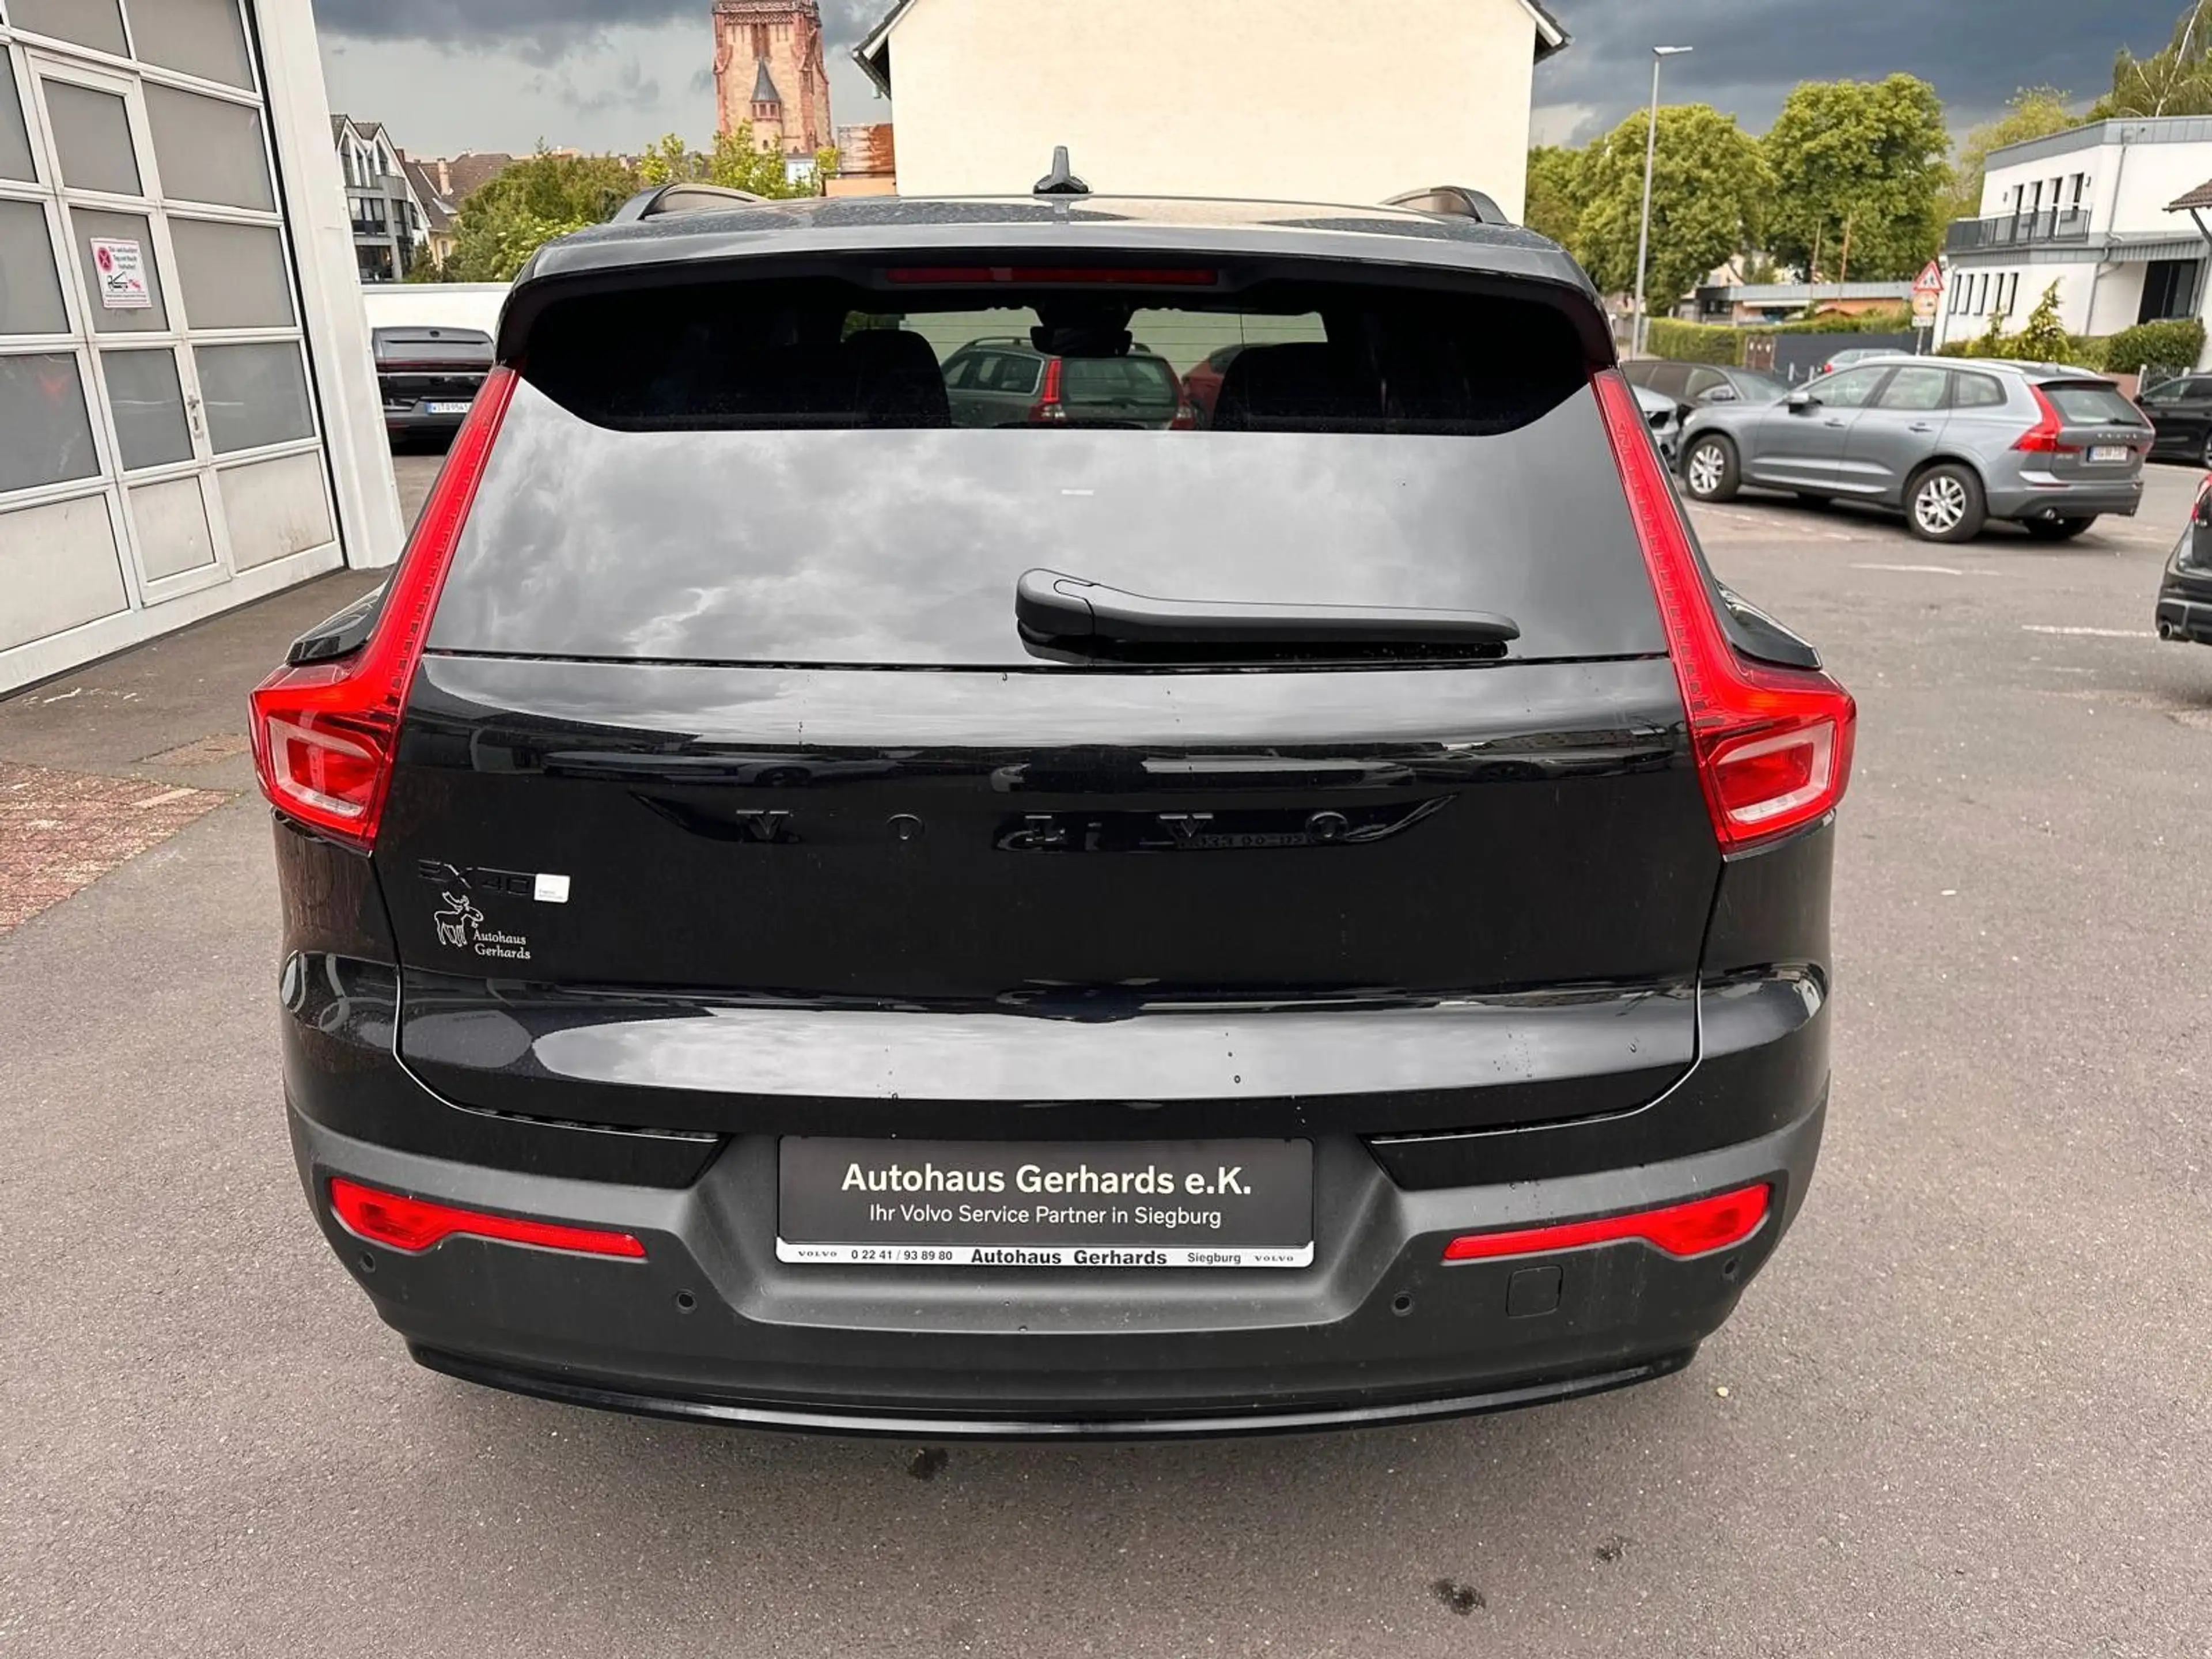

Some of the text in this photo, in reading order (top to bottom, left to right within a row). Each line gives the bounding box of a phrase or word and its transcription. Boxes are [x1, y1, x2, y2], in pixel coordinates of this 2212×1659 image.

[472, 929, 527, 945] Autohaus
[474, 942, 531, 960] Gerhards
[841, 1162, 1252, 1195] Autohaus Gerhards e.K.
[870, 1203, 1222, 1229] Ihr Volvo Service Partner in Siegburg
[851, 1249, 858, 1260] 0
[862, 1249, 876, 1260] 22
[878, 1250, 892, 1260] 41
[904, 1250, 918, 1260] 93
[921, 1250, 935, 1261] 89
[938, 1251, 953, 1261] 80
[971, 1248, 1062, 1264] Autohaus
[1073, 1249, 1168, 1265] Gerhards
[1187, 1252, 1241, 1264] Siegburg
